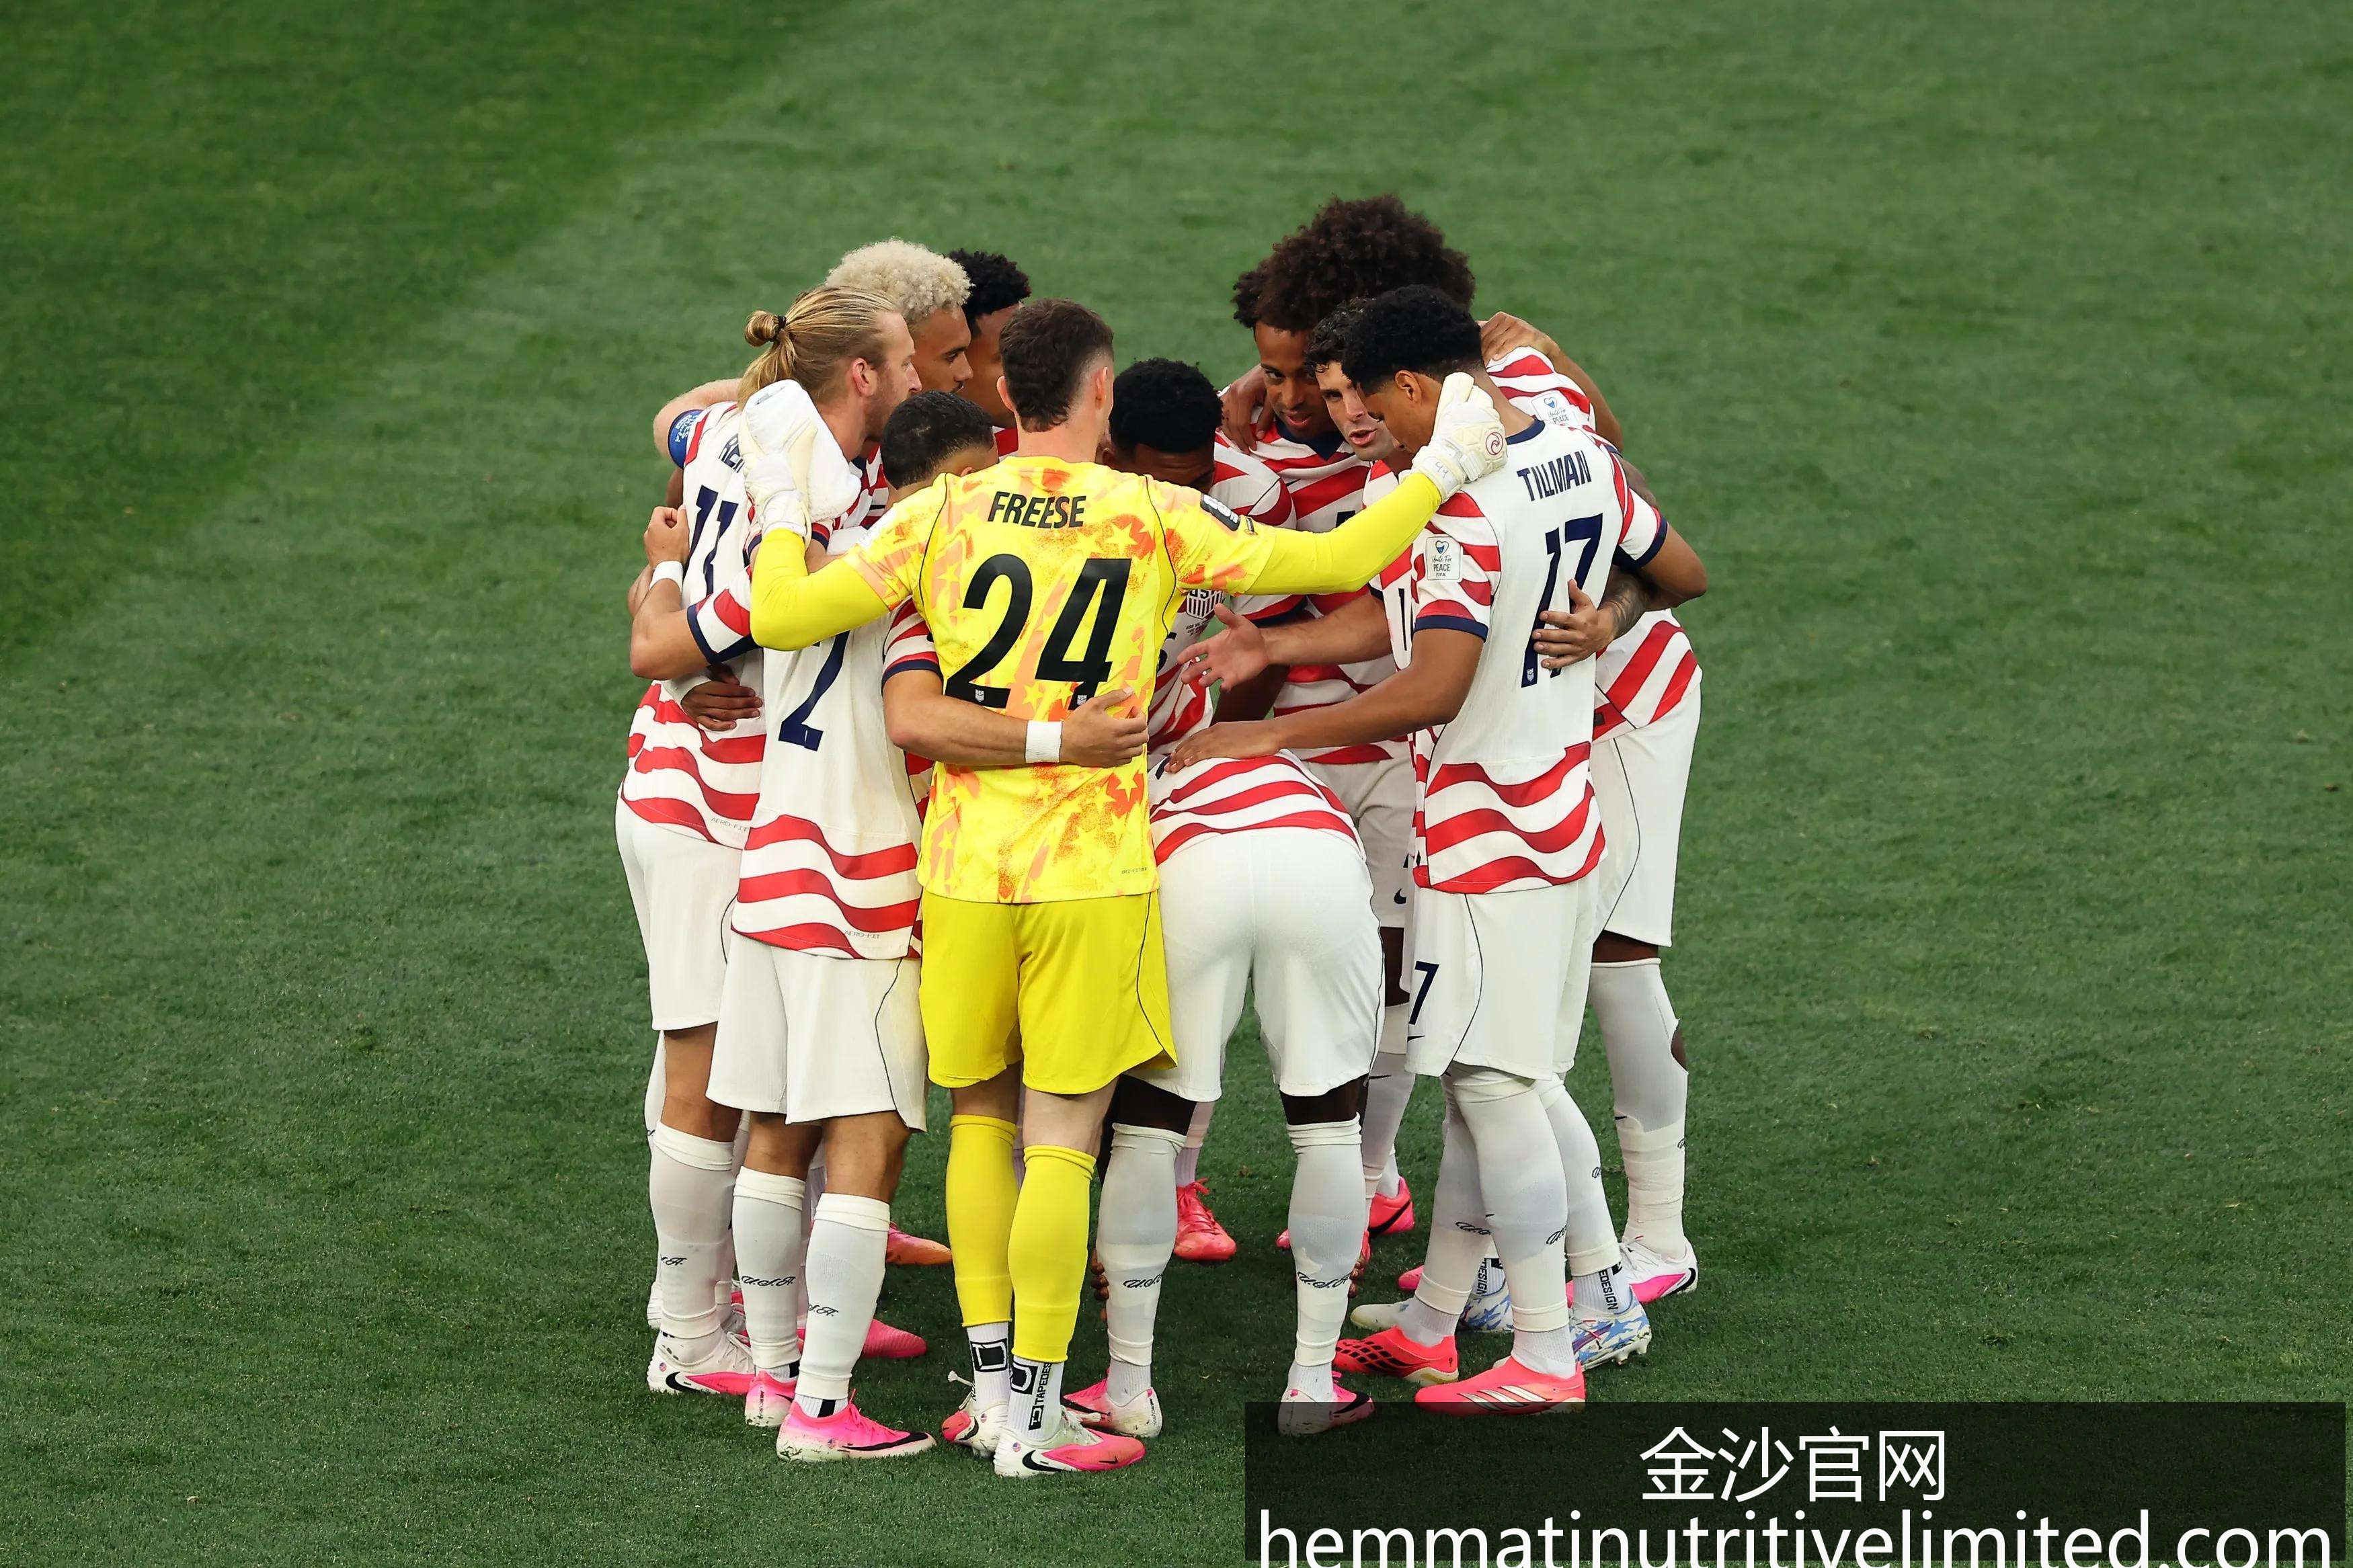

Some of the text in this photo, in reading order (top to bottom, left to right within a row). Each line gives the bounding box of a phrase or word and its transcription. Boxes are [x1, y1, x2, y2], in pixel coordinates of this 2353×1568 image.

[1517, 450, 1592, 501] TILLMAN
[988, 491, 1086, 528] FREESE
[1433, 563, 1451, 571] PEACE
[1521, 513, 1603, 688] 17
[943, 553, 1132, 710] 24
[778, 630, 849, 751] 2
[845, 930, 880, 939] AERO-FIT
[1408, 961, 1439, 1025] 7
[742, 1276, 796, 1286] U.S.A.
